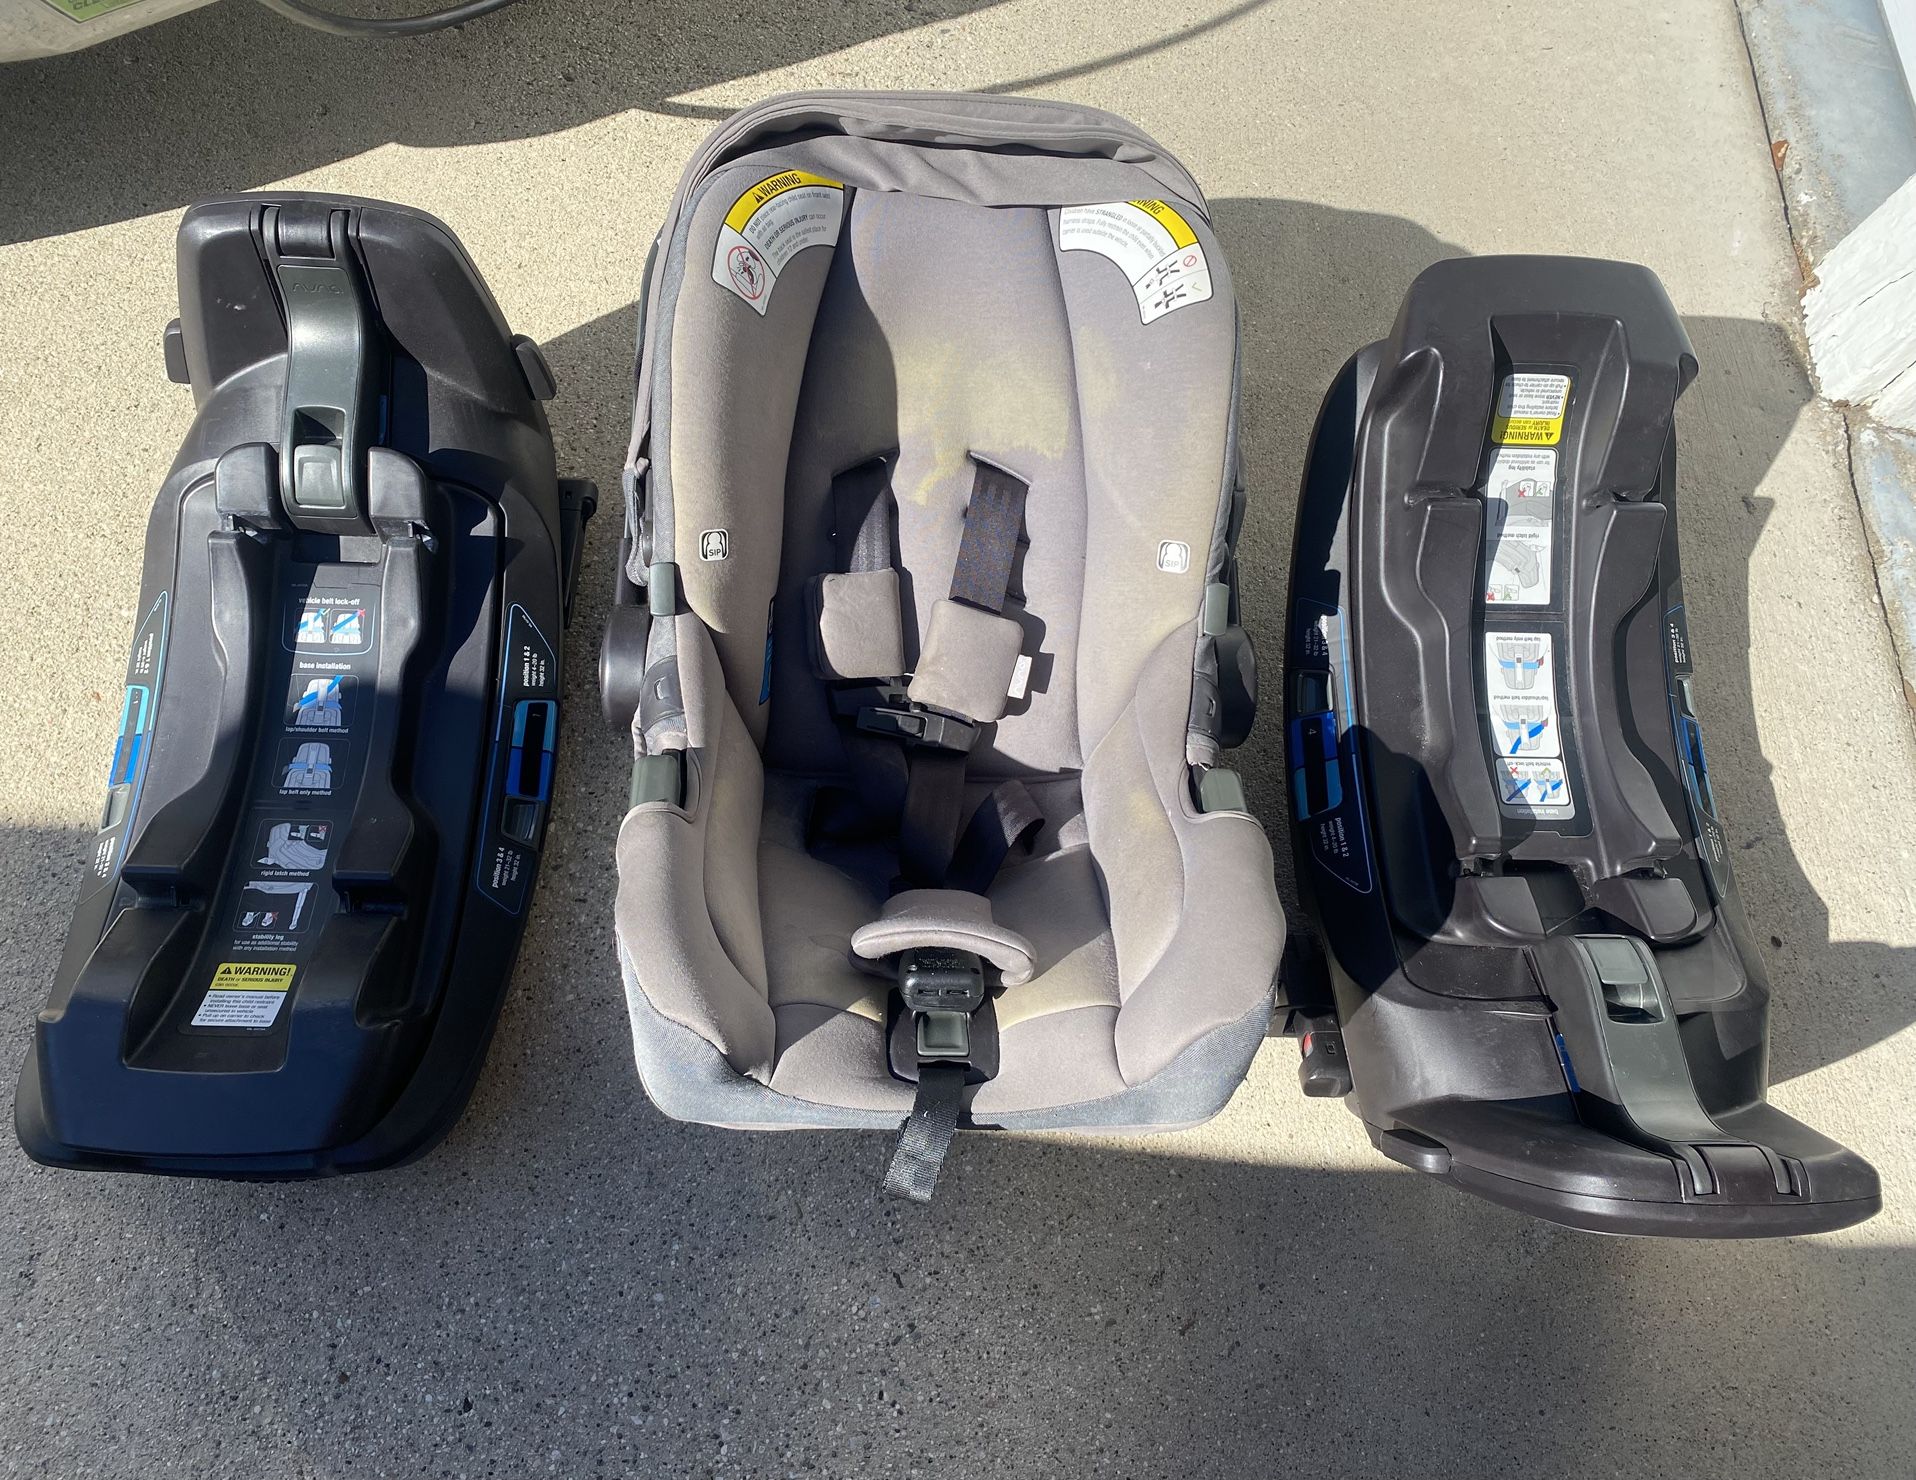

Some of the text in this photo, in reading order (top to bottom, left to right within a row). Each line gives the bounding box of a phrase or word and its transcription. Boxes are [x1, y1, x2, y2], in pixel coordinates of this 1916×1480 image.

[761, 173, 801, 197] WARNING
[1095, 208, 1123, 221] STRANGLED
[749, 225, 757, 234] DO
[764, 235, 776, 250] DEATH
[779, 219, 795, 234] SERIOUS
[794, 214, 809, 225] INJURY
[1500, 431, 1543, 441] WARNING!
[709, 549, 721, 557] SIP
[1165, 559, 1180, 568] SIP
[321, 597, 334, 605] belt
[335, 597, 361, 606] lock-off
[299, 661, 352, 670] base installation
[522, 662, 530, 687] position
[285, 726, 318, 734] lap/shoulder
[279, 788, 288, 796] lap
[299, 789, 311, 797] only
[1334, 817, 1345, 841] position
[492, 863, 501, 889] position
[234, 966, 291, 977] WARNING!
